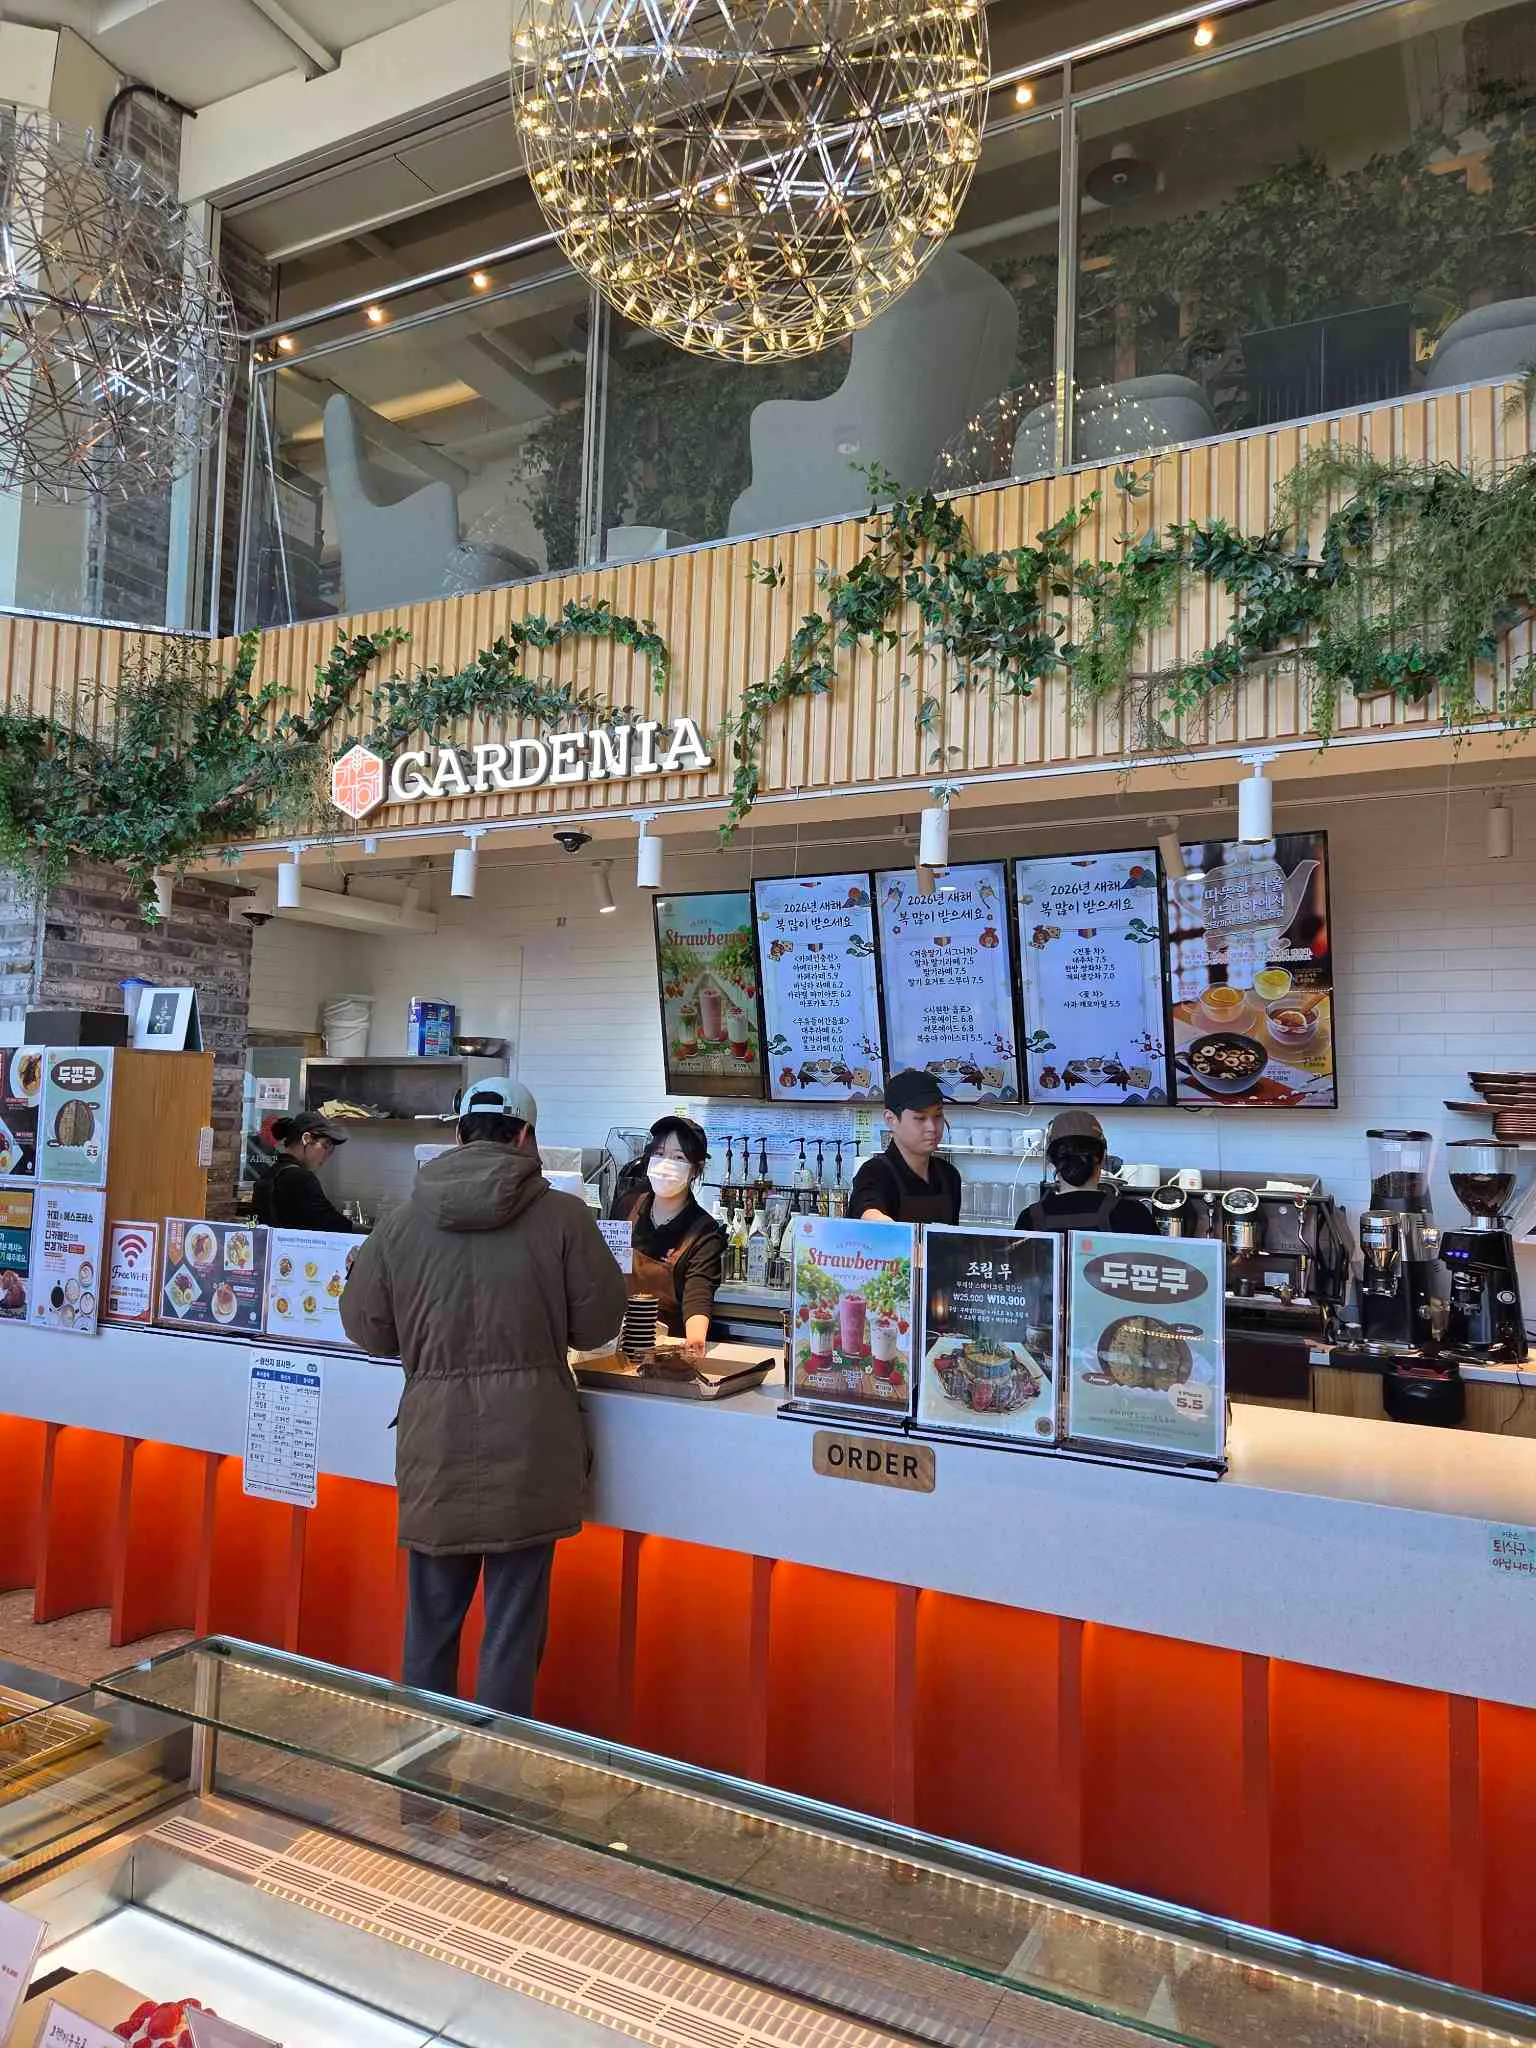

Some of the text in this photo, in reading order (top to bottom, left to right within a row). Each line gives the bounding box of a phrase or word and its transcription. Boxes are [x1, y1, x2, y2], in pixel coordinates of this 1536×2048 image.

[391, 717, 714, 800] GARDENIA
[1050, 880, 1121, 896] 2026년 새해
[1204, 881, 1249, 902] 따뜻한
[908, 891, 972, 906] 2026년 새해
[784, 900, 841, 913] 2026년 새해
[1040, 898, 1135, 917] 복 많이 받으세요
[776, 916, 853, 931] 복 많이 받으세요
[899, 908, 985, 926] 복 많이 받으세요
[792, 963, 828, 972] 아메리카노
[962, 957, 974, 965] 7.5
[794, 982, 814, 990] 바닐라
[924, 977, 946, 986] 요거트
[947, 976, 970, 985] 스무디
[971, 976, 984, 984] 7.5
[829, 1000, 840, 1008] 7.5
[1063, 1000, 1077, 1008] 사과
[831, 1026, 843, 1034] 6.5
[923, 1024, 960, 1033] 레몬에이드
[832, 1035, 843, 1043] 6.0
[939, 1033, 969, 1044] 아이스티
[970, 1033, 983, 1041] 5.5
[58, 1066, 97, 1084] 두쫀쿠
[64, 1211, 95, 1223] 에스프레소
[808, 1247, 899, 1277] Strawberry
[111, 1264, 129, 1279] Free
[965, 1261, 1012, 1280] 조림 무
[1101, 1261, 1190, 1295] 두쫀쿠
[1176, 1398, 1204, 1411] 5.5
[827, 1444, 918, 1479] ORDER
